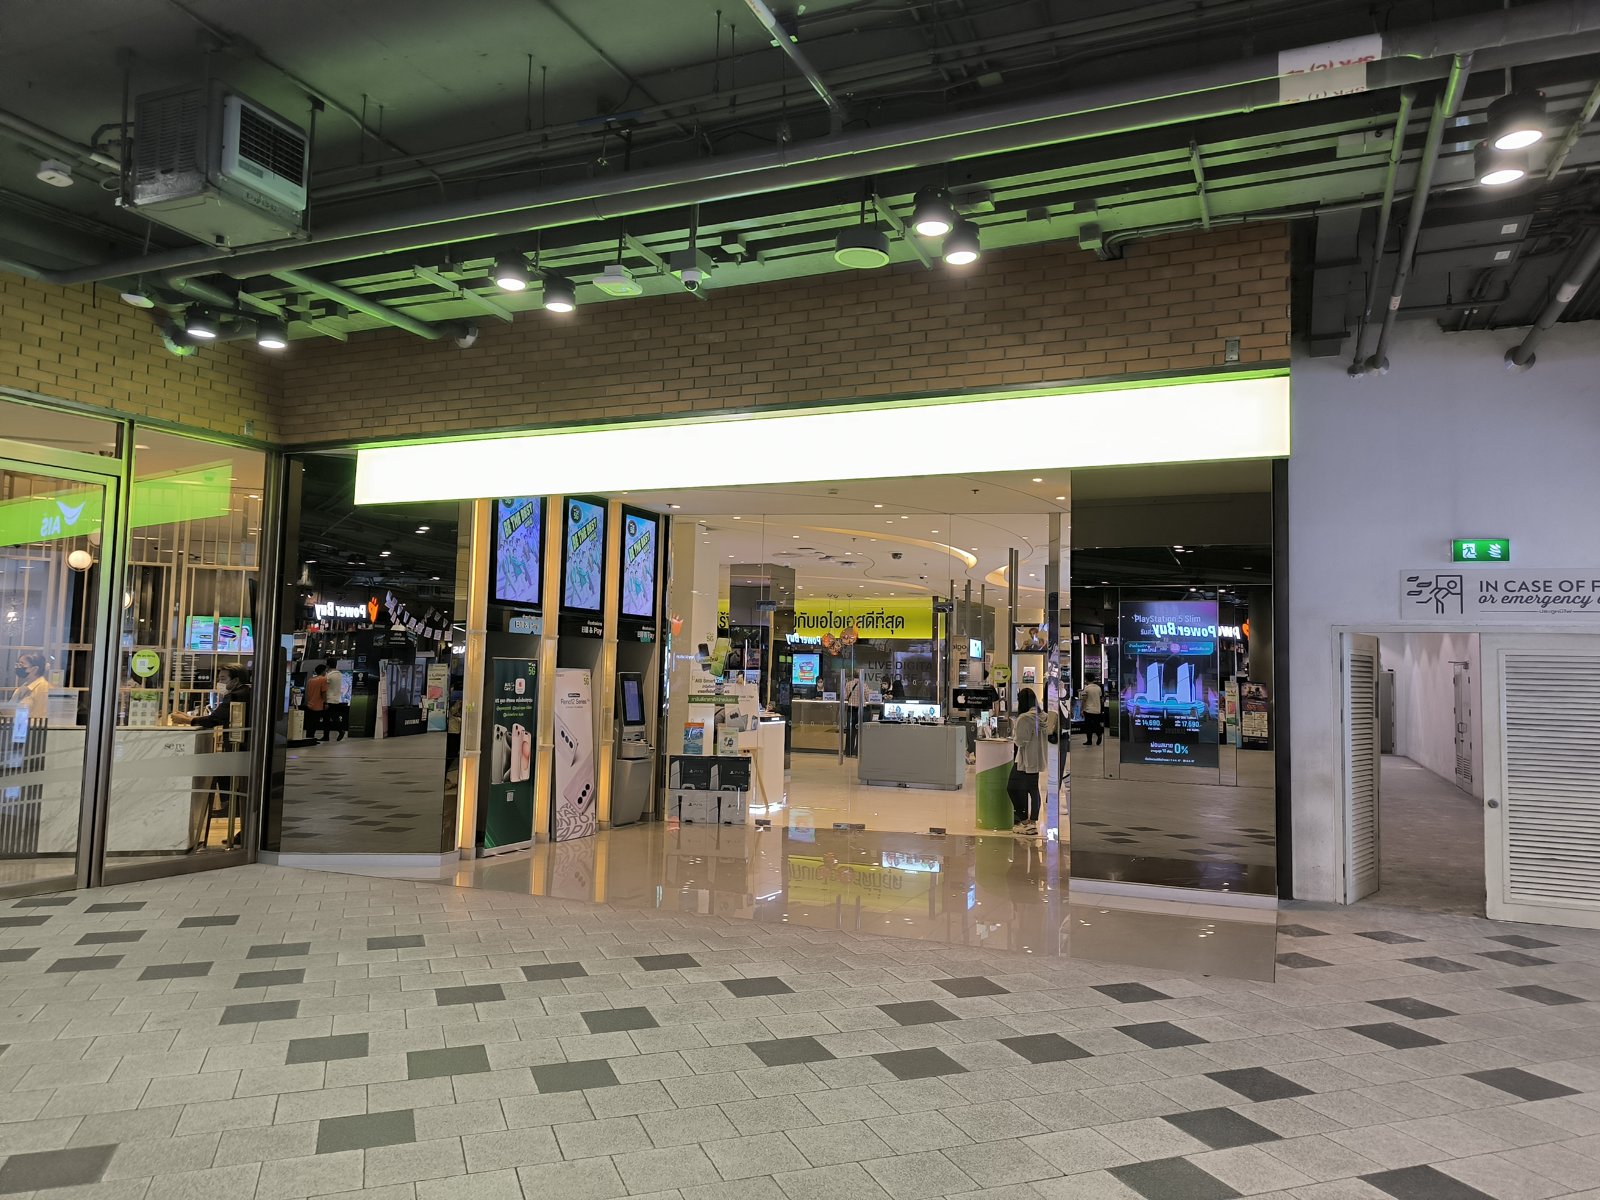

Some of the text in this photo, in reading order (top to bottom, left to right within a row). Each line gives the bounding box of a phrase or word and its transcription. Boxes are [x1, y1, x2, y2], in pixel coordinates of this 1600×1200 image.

[1480, 580, 1498, 593] IN
[1503, 580, 1553, 593] CASE
[1558, 580, 1586, 593] OF
[1478, 594, 1497, 604] or
[1501, 594, 1593, 608] emergency
[1134, 614, 1177, 624] PlayStation
[594, 626, 603, 636] Pay
[868, 661, 932, 670] LIVE DIGITA
[1174, 743, 1189, 755] 0%
